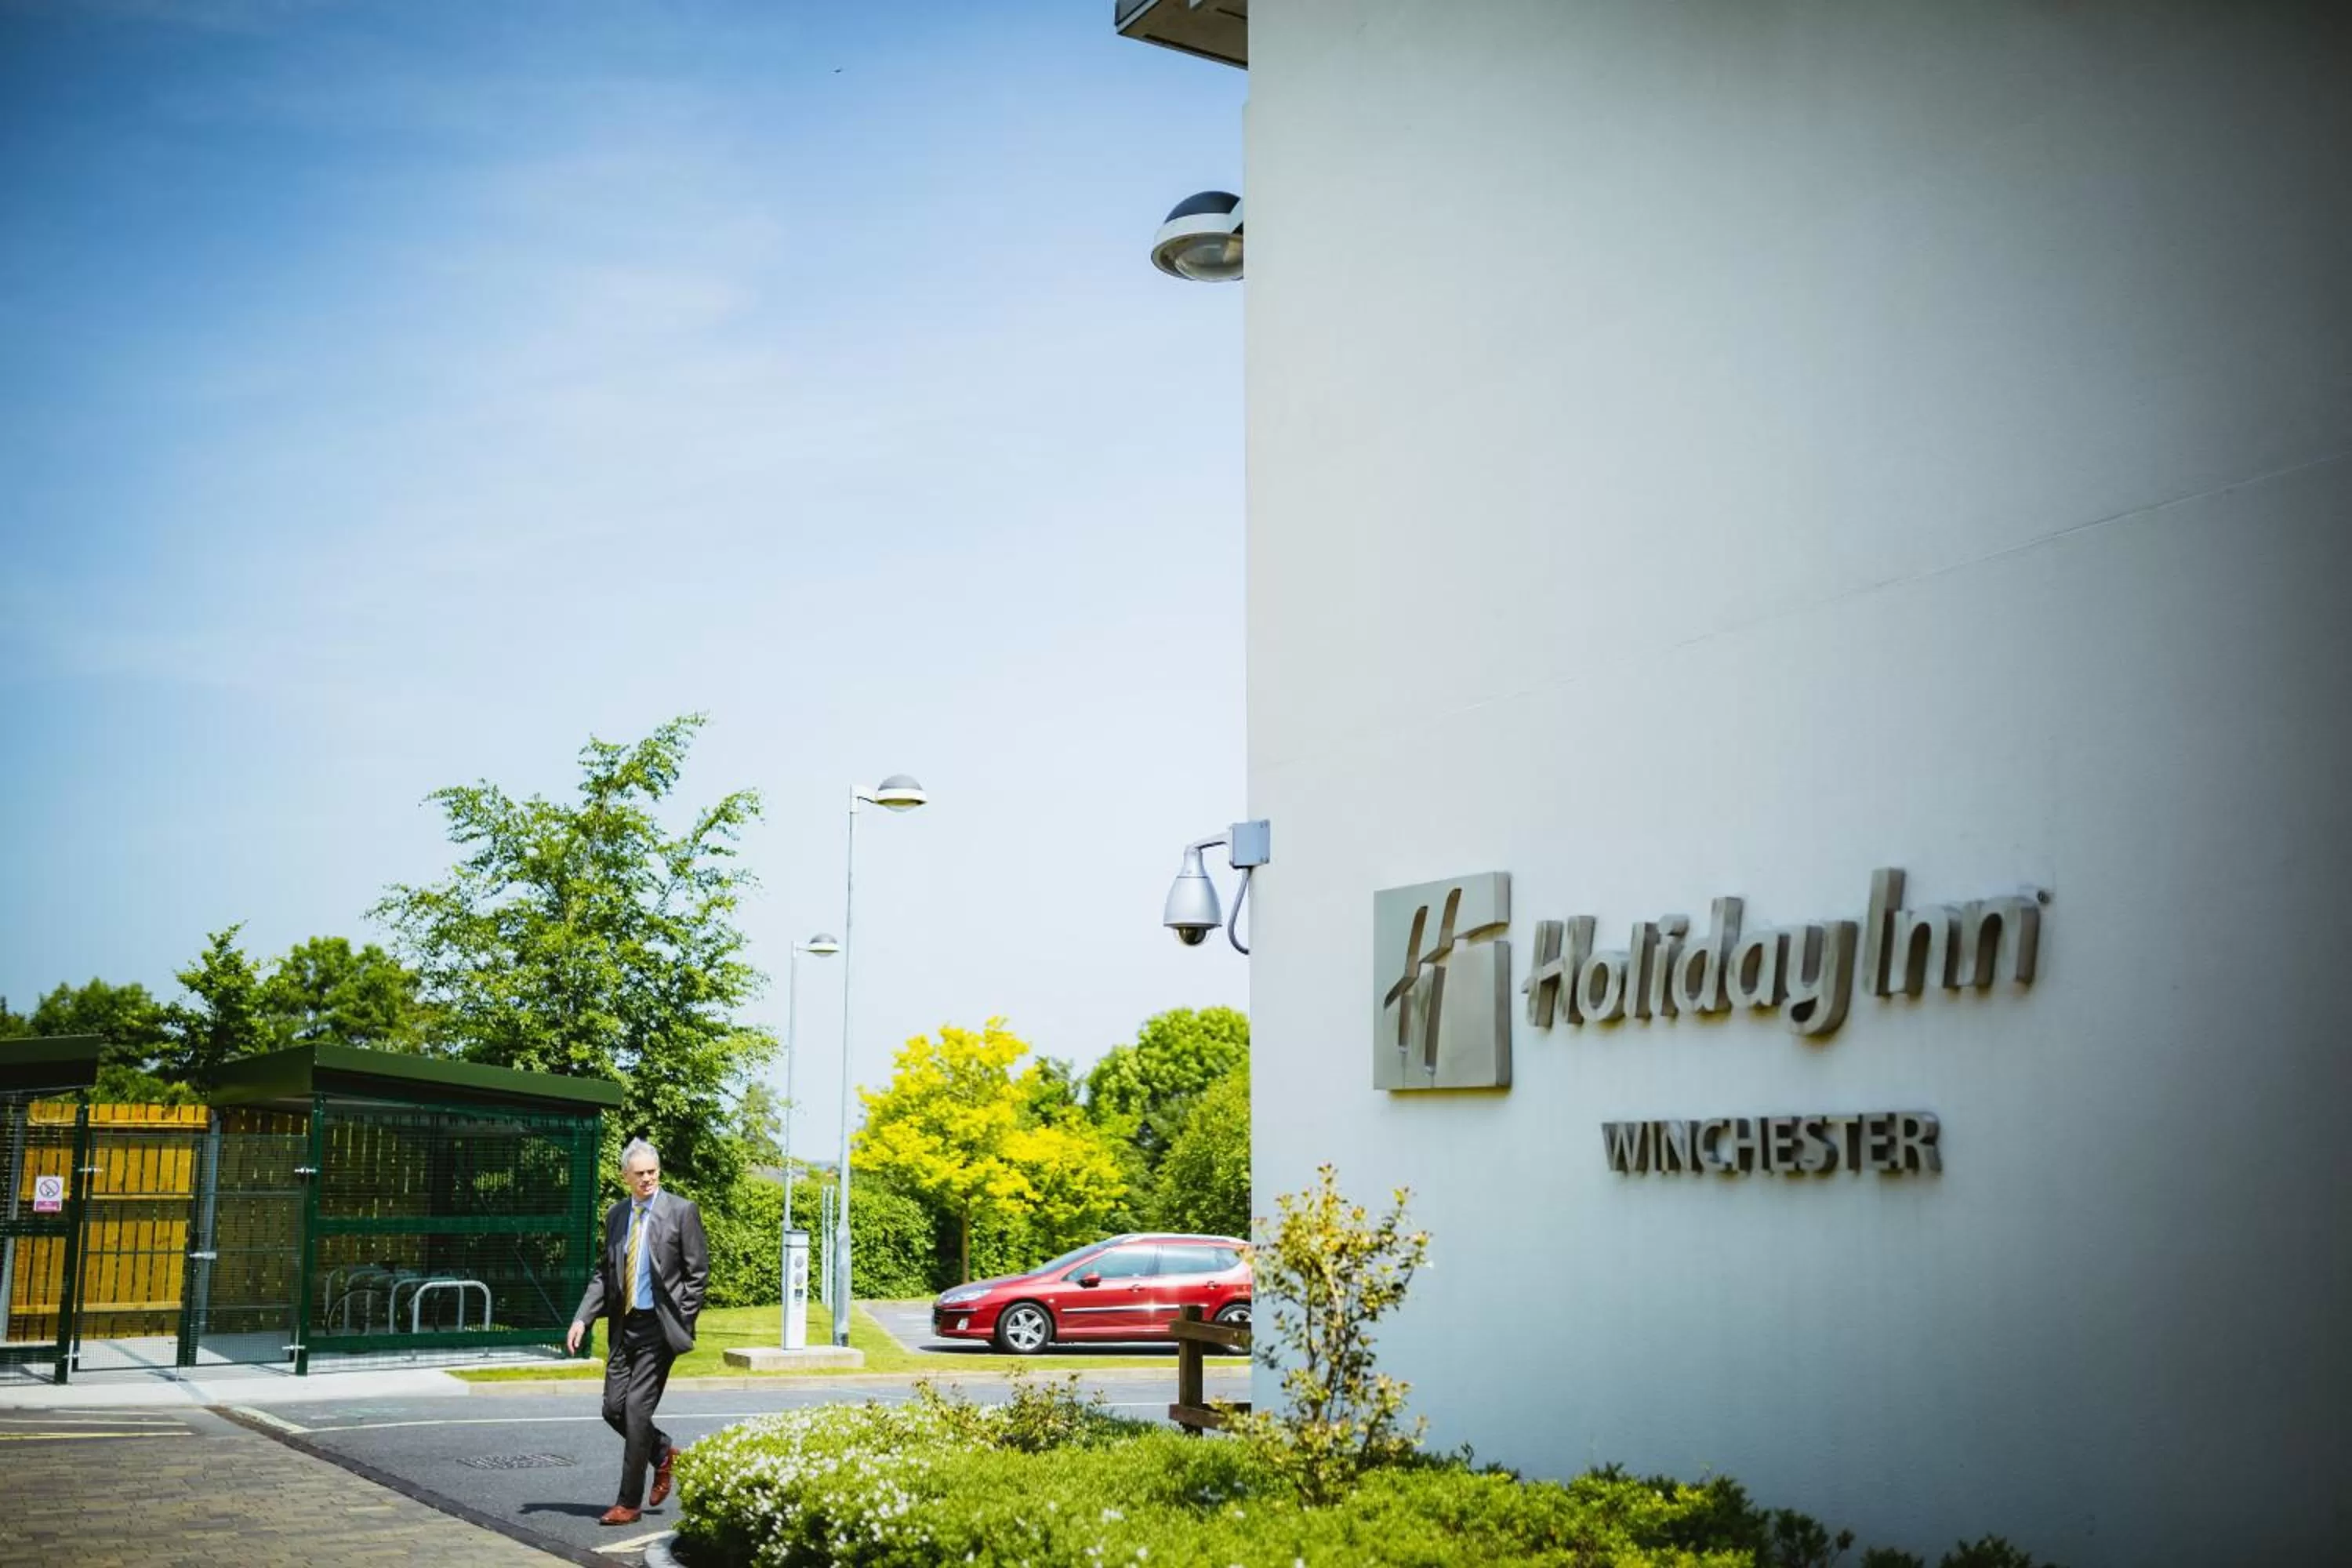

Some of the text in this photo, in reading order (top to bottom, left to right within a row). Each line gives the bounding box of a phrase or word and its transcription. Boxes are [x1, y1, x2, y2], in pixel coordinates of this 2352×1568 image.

[1521, 868, 2040, 1036] Holiday Inn
[1601, 1110, 1943, 1176] WINCHESTER
